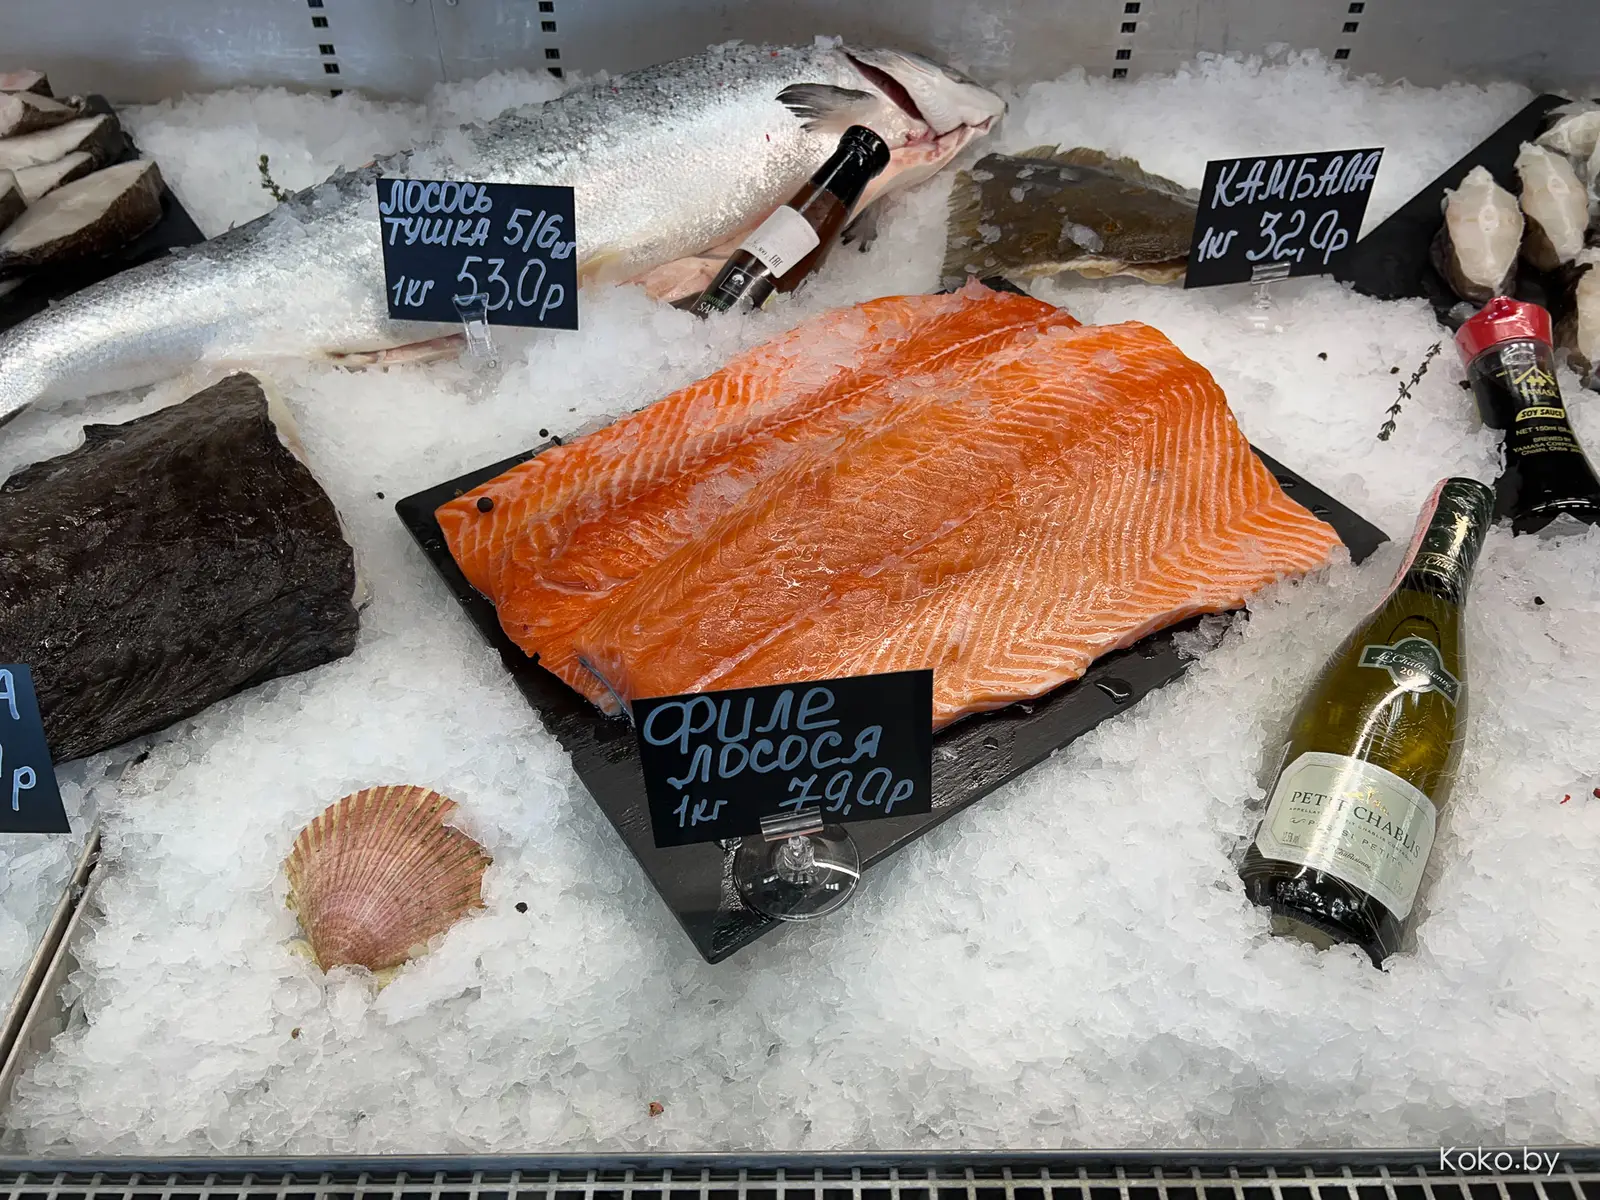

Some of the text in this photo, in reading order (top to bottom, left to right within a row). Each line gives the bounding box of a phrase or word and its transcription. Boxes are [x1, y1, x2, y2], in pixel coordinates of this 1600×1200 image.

[1211, 151, 1382, 209] КАМБАЛА
[380, 180, 493, 215] ЛОСОСЬ
[384, 216, 491, 246] ТУШКА
[392, 275, 435, 306] 1кг
[1521, 409, 1562, 418] SOY SAUCE
[1516, 427, 1532, 436] NET
[643, 687, 839, 754] ФИЛЕ
[673, 795, 727, 827] 1кг
[1353, 806, 1421, 859] CHABLIS
